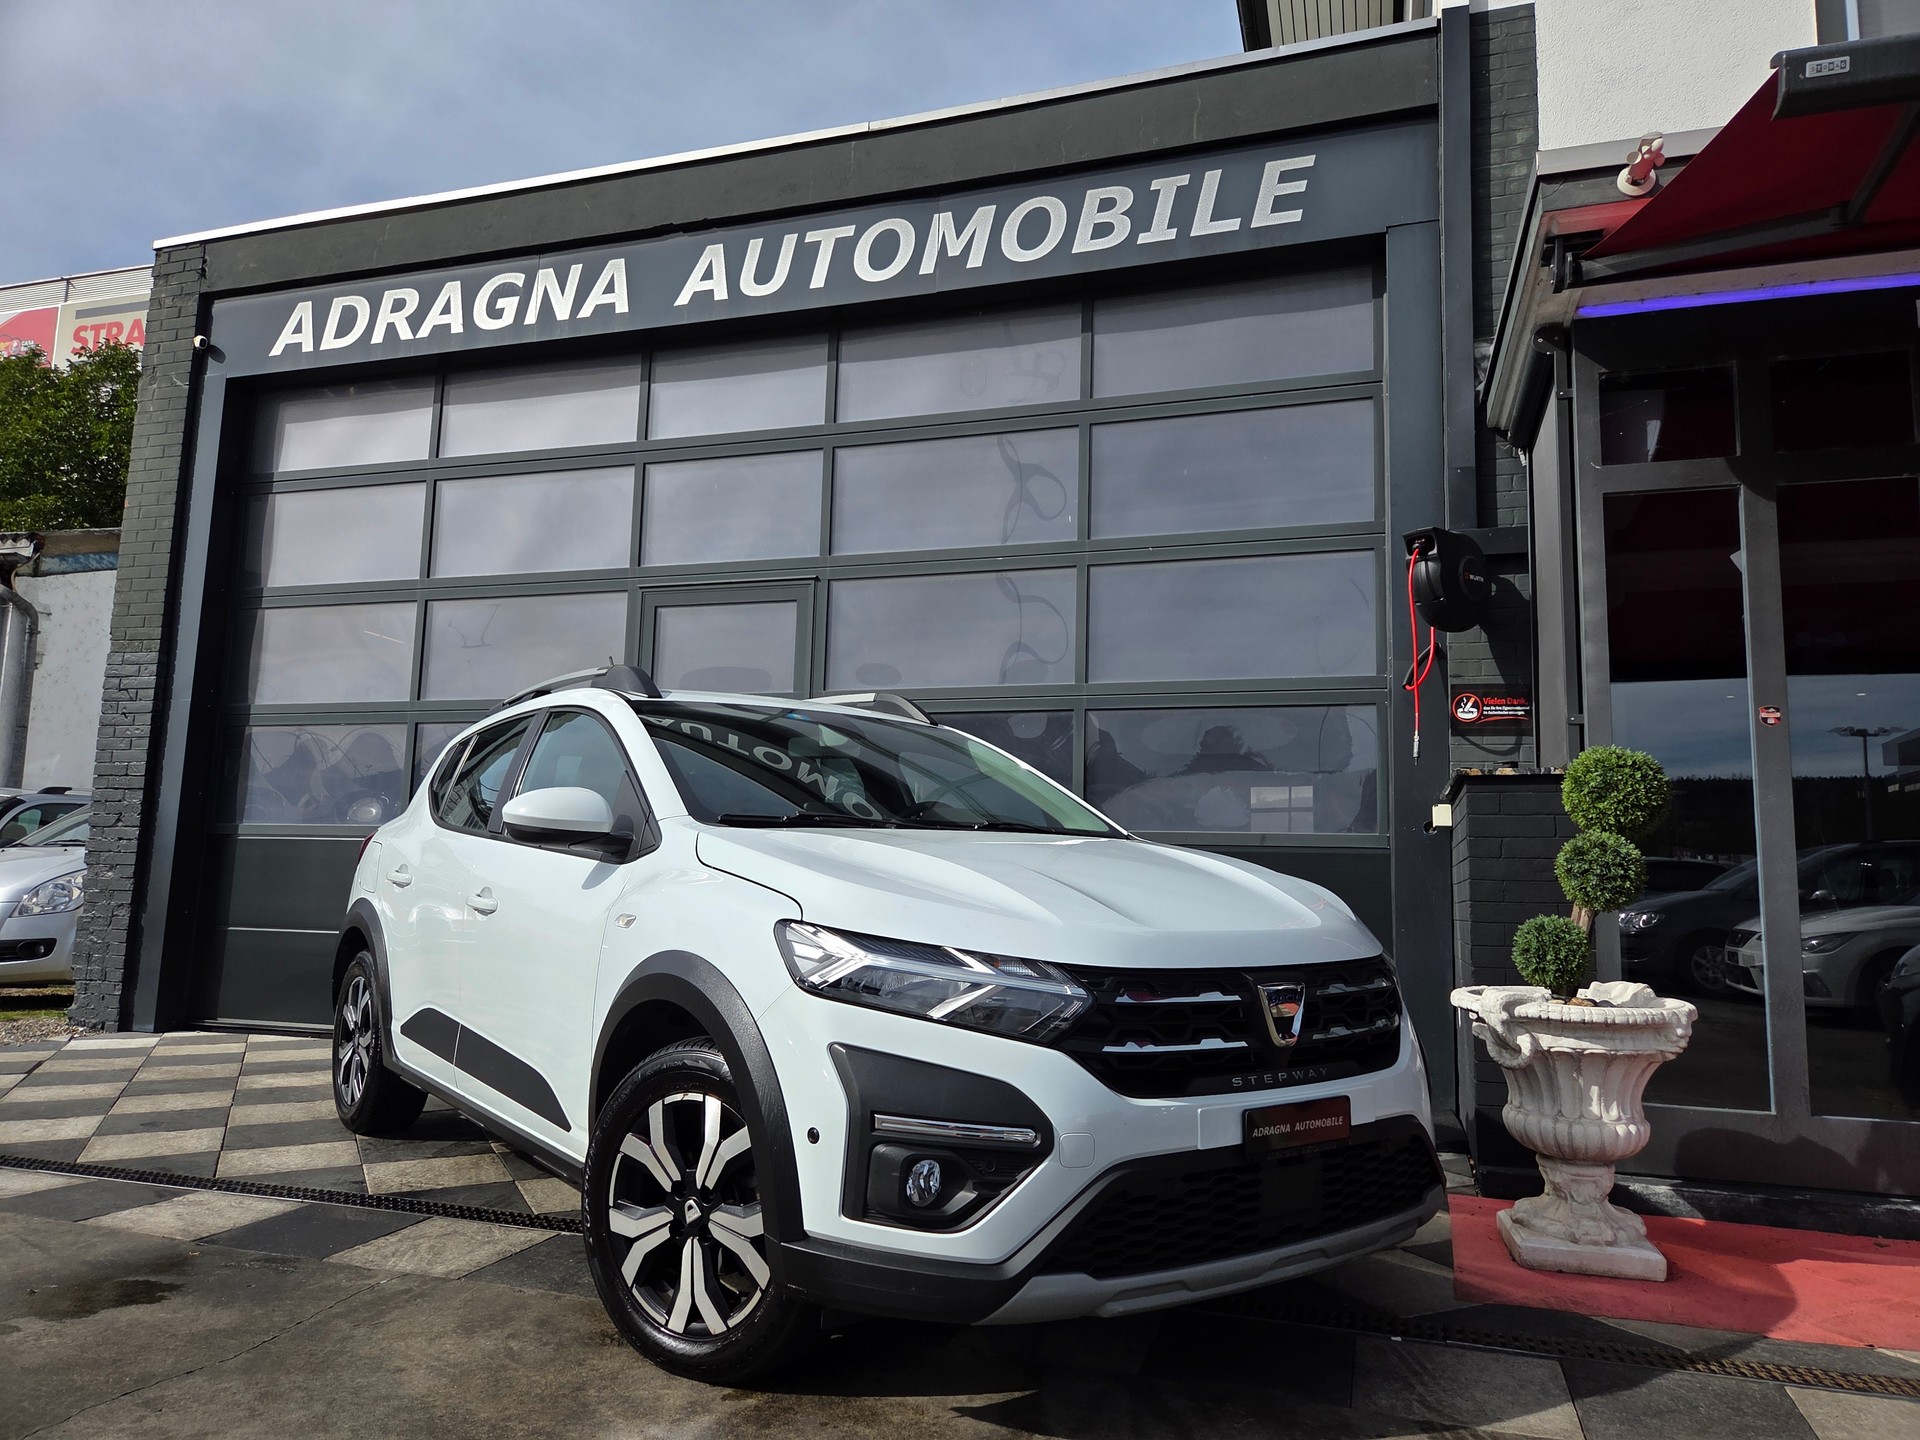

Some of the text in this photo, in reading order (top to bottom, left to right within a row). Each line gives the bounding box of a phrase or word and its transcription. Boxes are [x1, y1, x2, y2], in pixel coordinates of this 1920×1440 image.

[268, 154, 1317, 357] ADRAGNA AUTOMOBILE
[1482, 697, 1506, 705] Vielen
[1232, 1067, 1328, 1087] STEPWAY
[1252, 1115, 1344, 1138] ADRAGNA AUTOMOBILE
